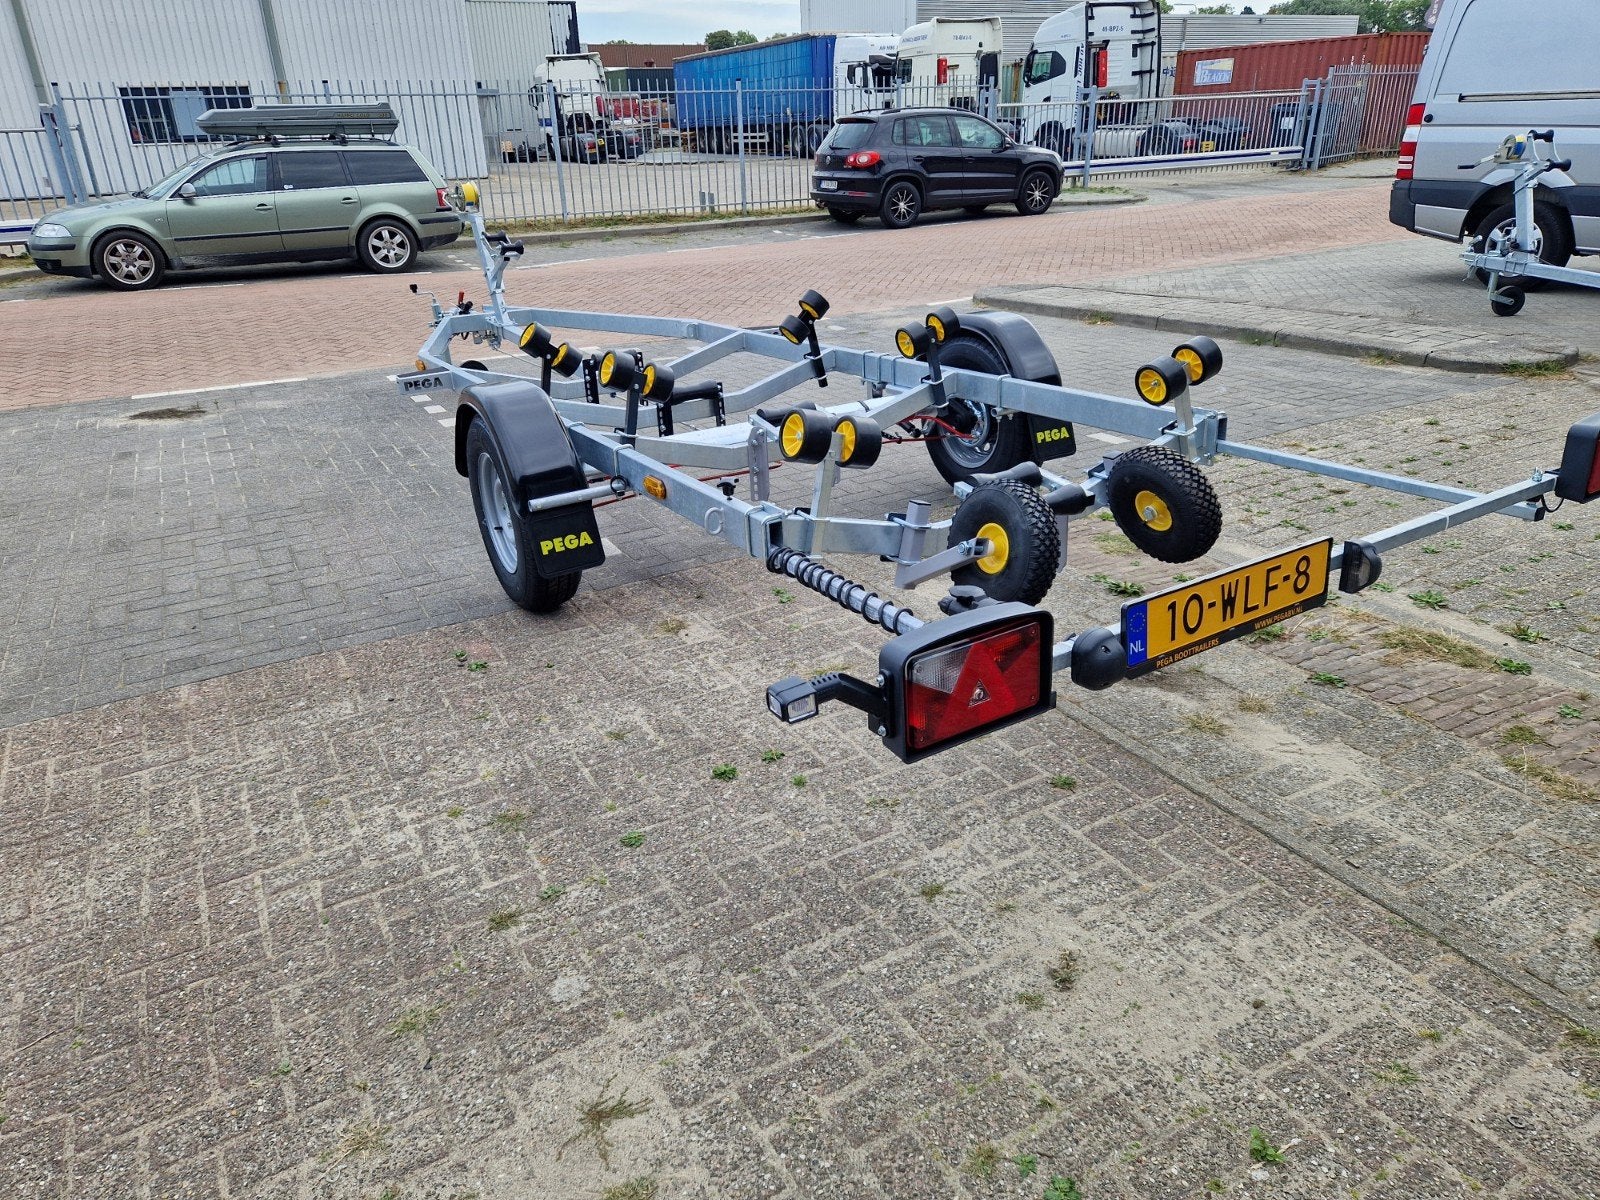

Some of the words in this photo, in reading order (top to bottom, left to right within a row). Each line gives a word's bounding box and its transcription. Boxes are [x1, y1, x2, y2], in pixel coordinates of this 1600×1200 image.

[404, 377, 443, 391] PEGA
[1036, 426, 1070, 444] PEGA
[540, 531, 594, 556] PEGA
[1167, 555, 1311, 642] 10-WLF-8
[1254, 605, 1303, 630] WWW.PEGABV.NL
[1129, 641, 1145, 655] NL
[1156, 655, 1174, 669] PEGA
[1174, 637, 1219, 661] BOOTTRAILERS
